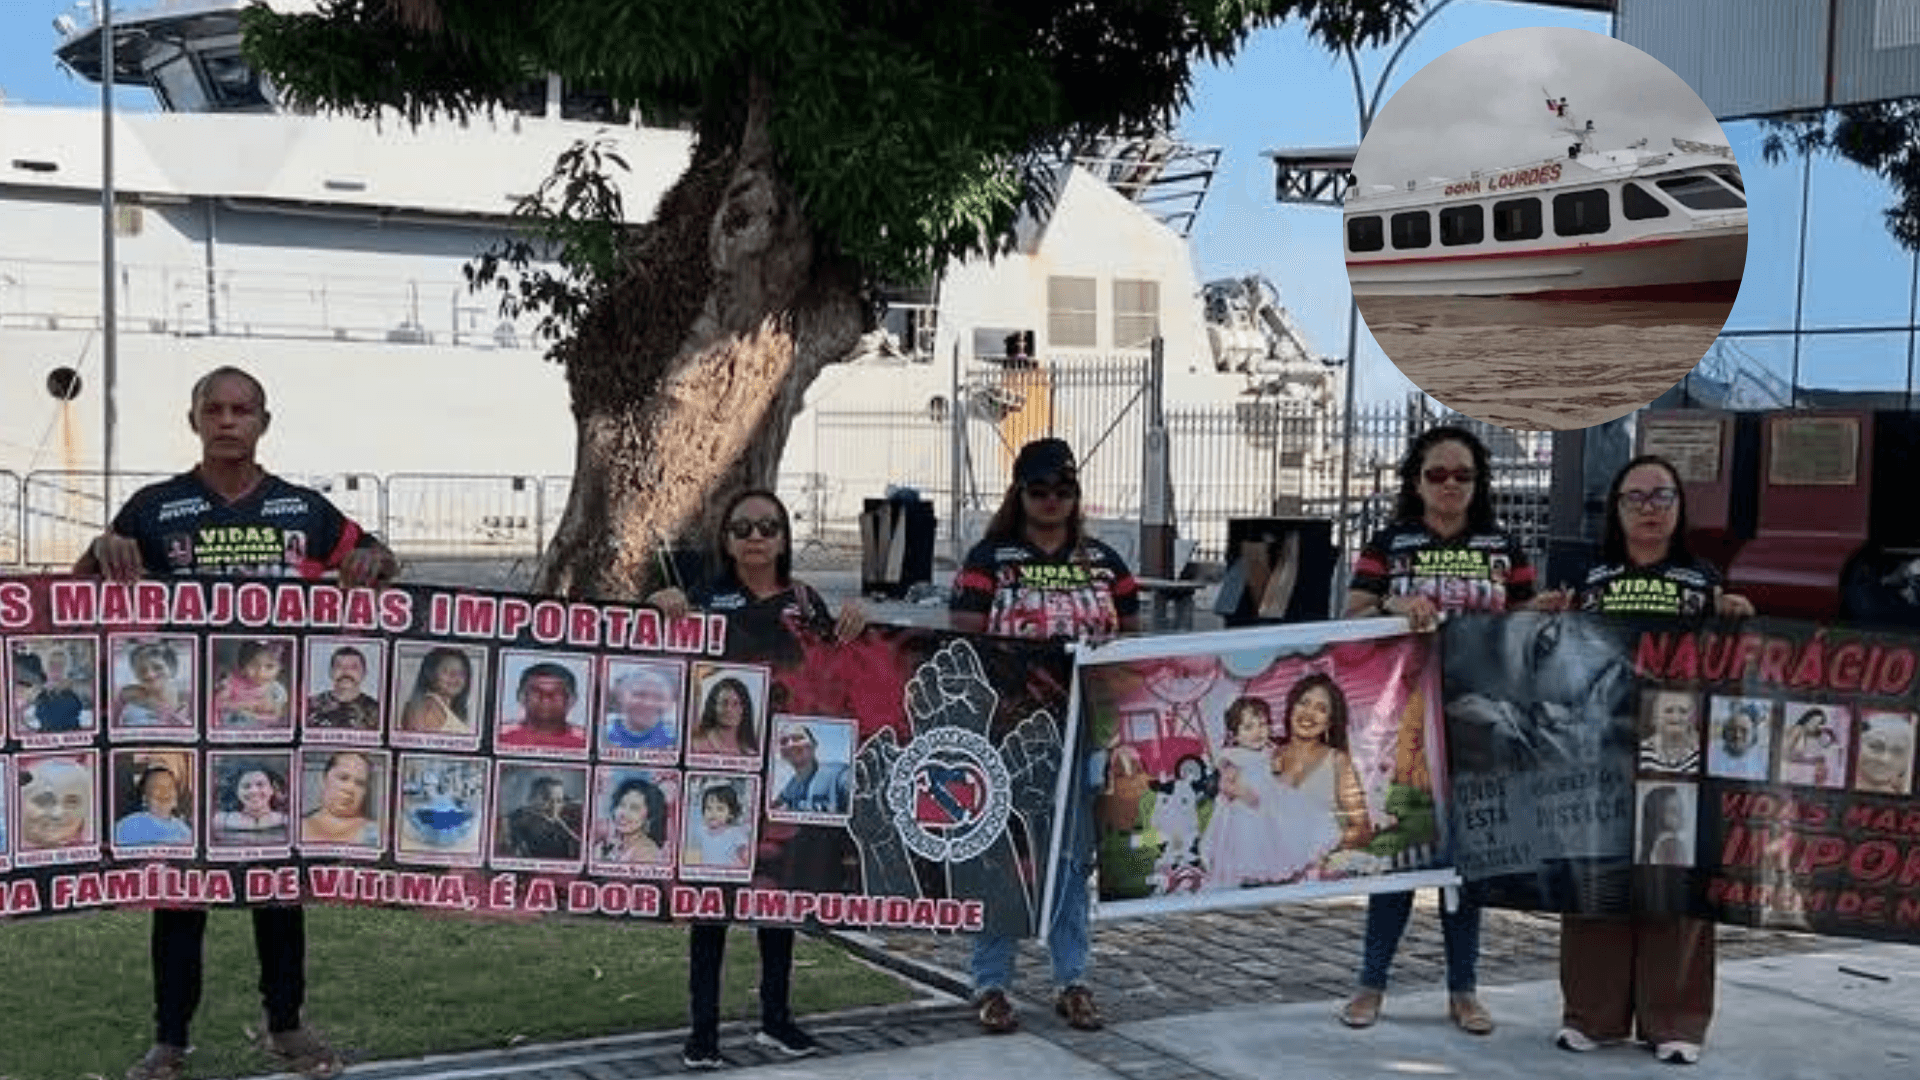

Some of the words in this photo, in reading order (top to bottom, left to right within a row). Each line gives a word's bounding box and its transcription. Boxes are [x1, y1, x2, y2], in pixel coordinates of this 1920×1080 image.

[1444, 180, 1482, 196] DONA
[1488, 163, 1562, 191] LOURDES
[200, 527, 278, 544] VIDAS
[1019, 564, 1086, 581] VIDAS
[1416, 550, 1484, 565] VIDAS
[1609, 578, 1679, 595] VIDAS
[0, 581, 33, 627] S
[51, 582, 412, 631] MARAJOARAS
[430, 595, 726, 656] IMPORTAM!
[1634, 629, 1912, 694] NAUFRÁGIO
[1721, 790, 1829, 827] VIDAS
[0, 875, 42, 914] A
[52, 864, 236, 909] FAMÍLIA
[247, 868, 300, 902] DE
[490, 871, 518, 909] É
[525, 877, 557, 911] A
[568, 882, 658, 915] DOR
[673, 885, 725, 918] DA
[736, 888, 984, 930] IMPUNIDADE
